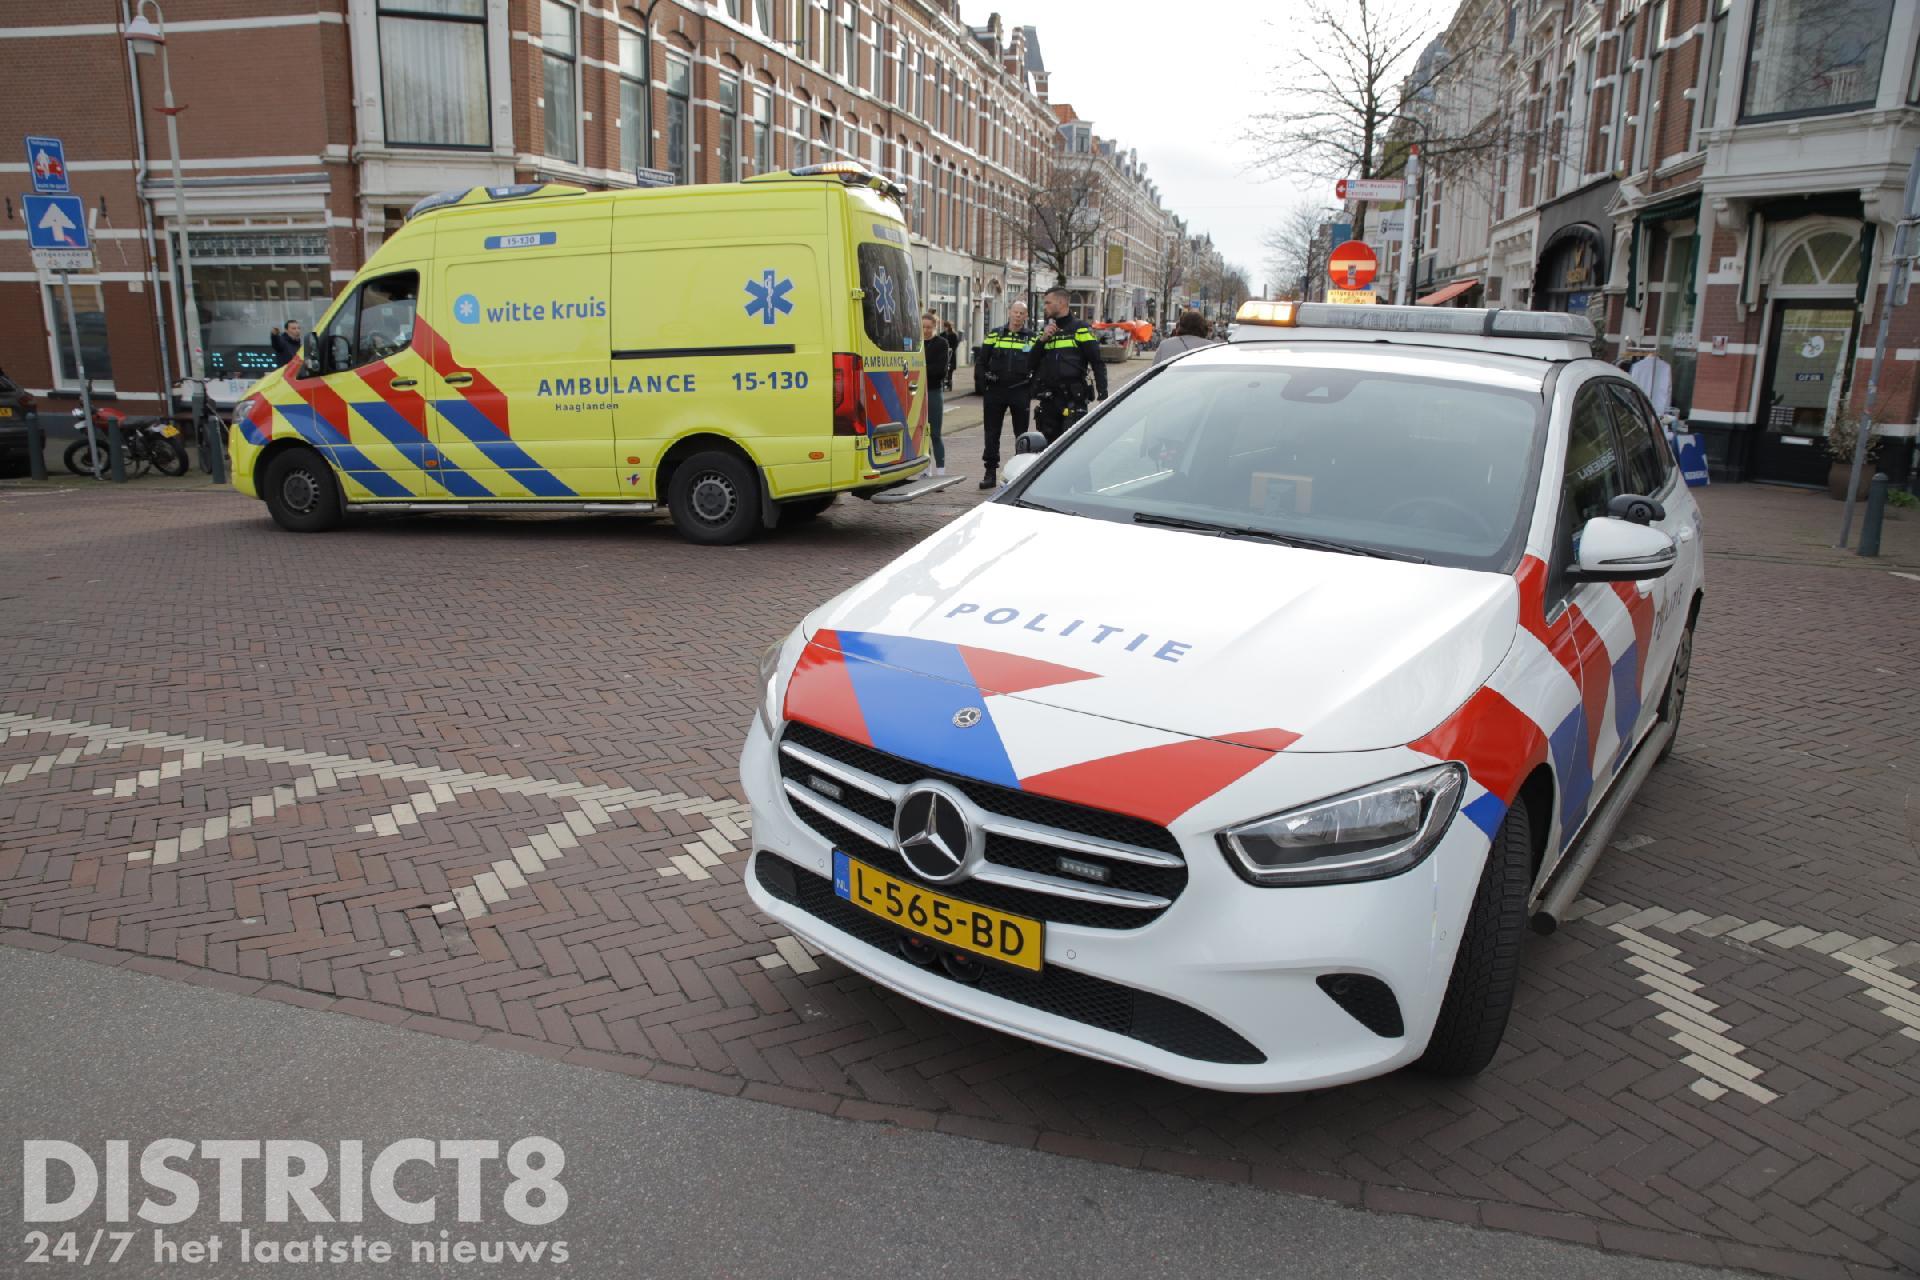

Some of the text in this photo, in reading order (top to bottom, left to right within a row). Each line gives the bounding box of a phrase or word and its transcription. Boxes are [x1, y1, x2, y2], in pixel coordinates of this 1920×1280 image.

[506, 235, 535, 246] 15-130
[487, 296, 607, 323] witte kruis
[863, 356, 904, 368] AMBULANCE
[537, 374, 696, 396] AMBULANCE
[731, 371, 809, 391] 15-130
[555, 402, 619, 413] Haaglanden
[944, 602, 1192, 663] POLITIE
[836, 878, 848, 893] NL
[857, 867, 1024, 956] L-565-BD
